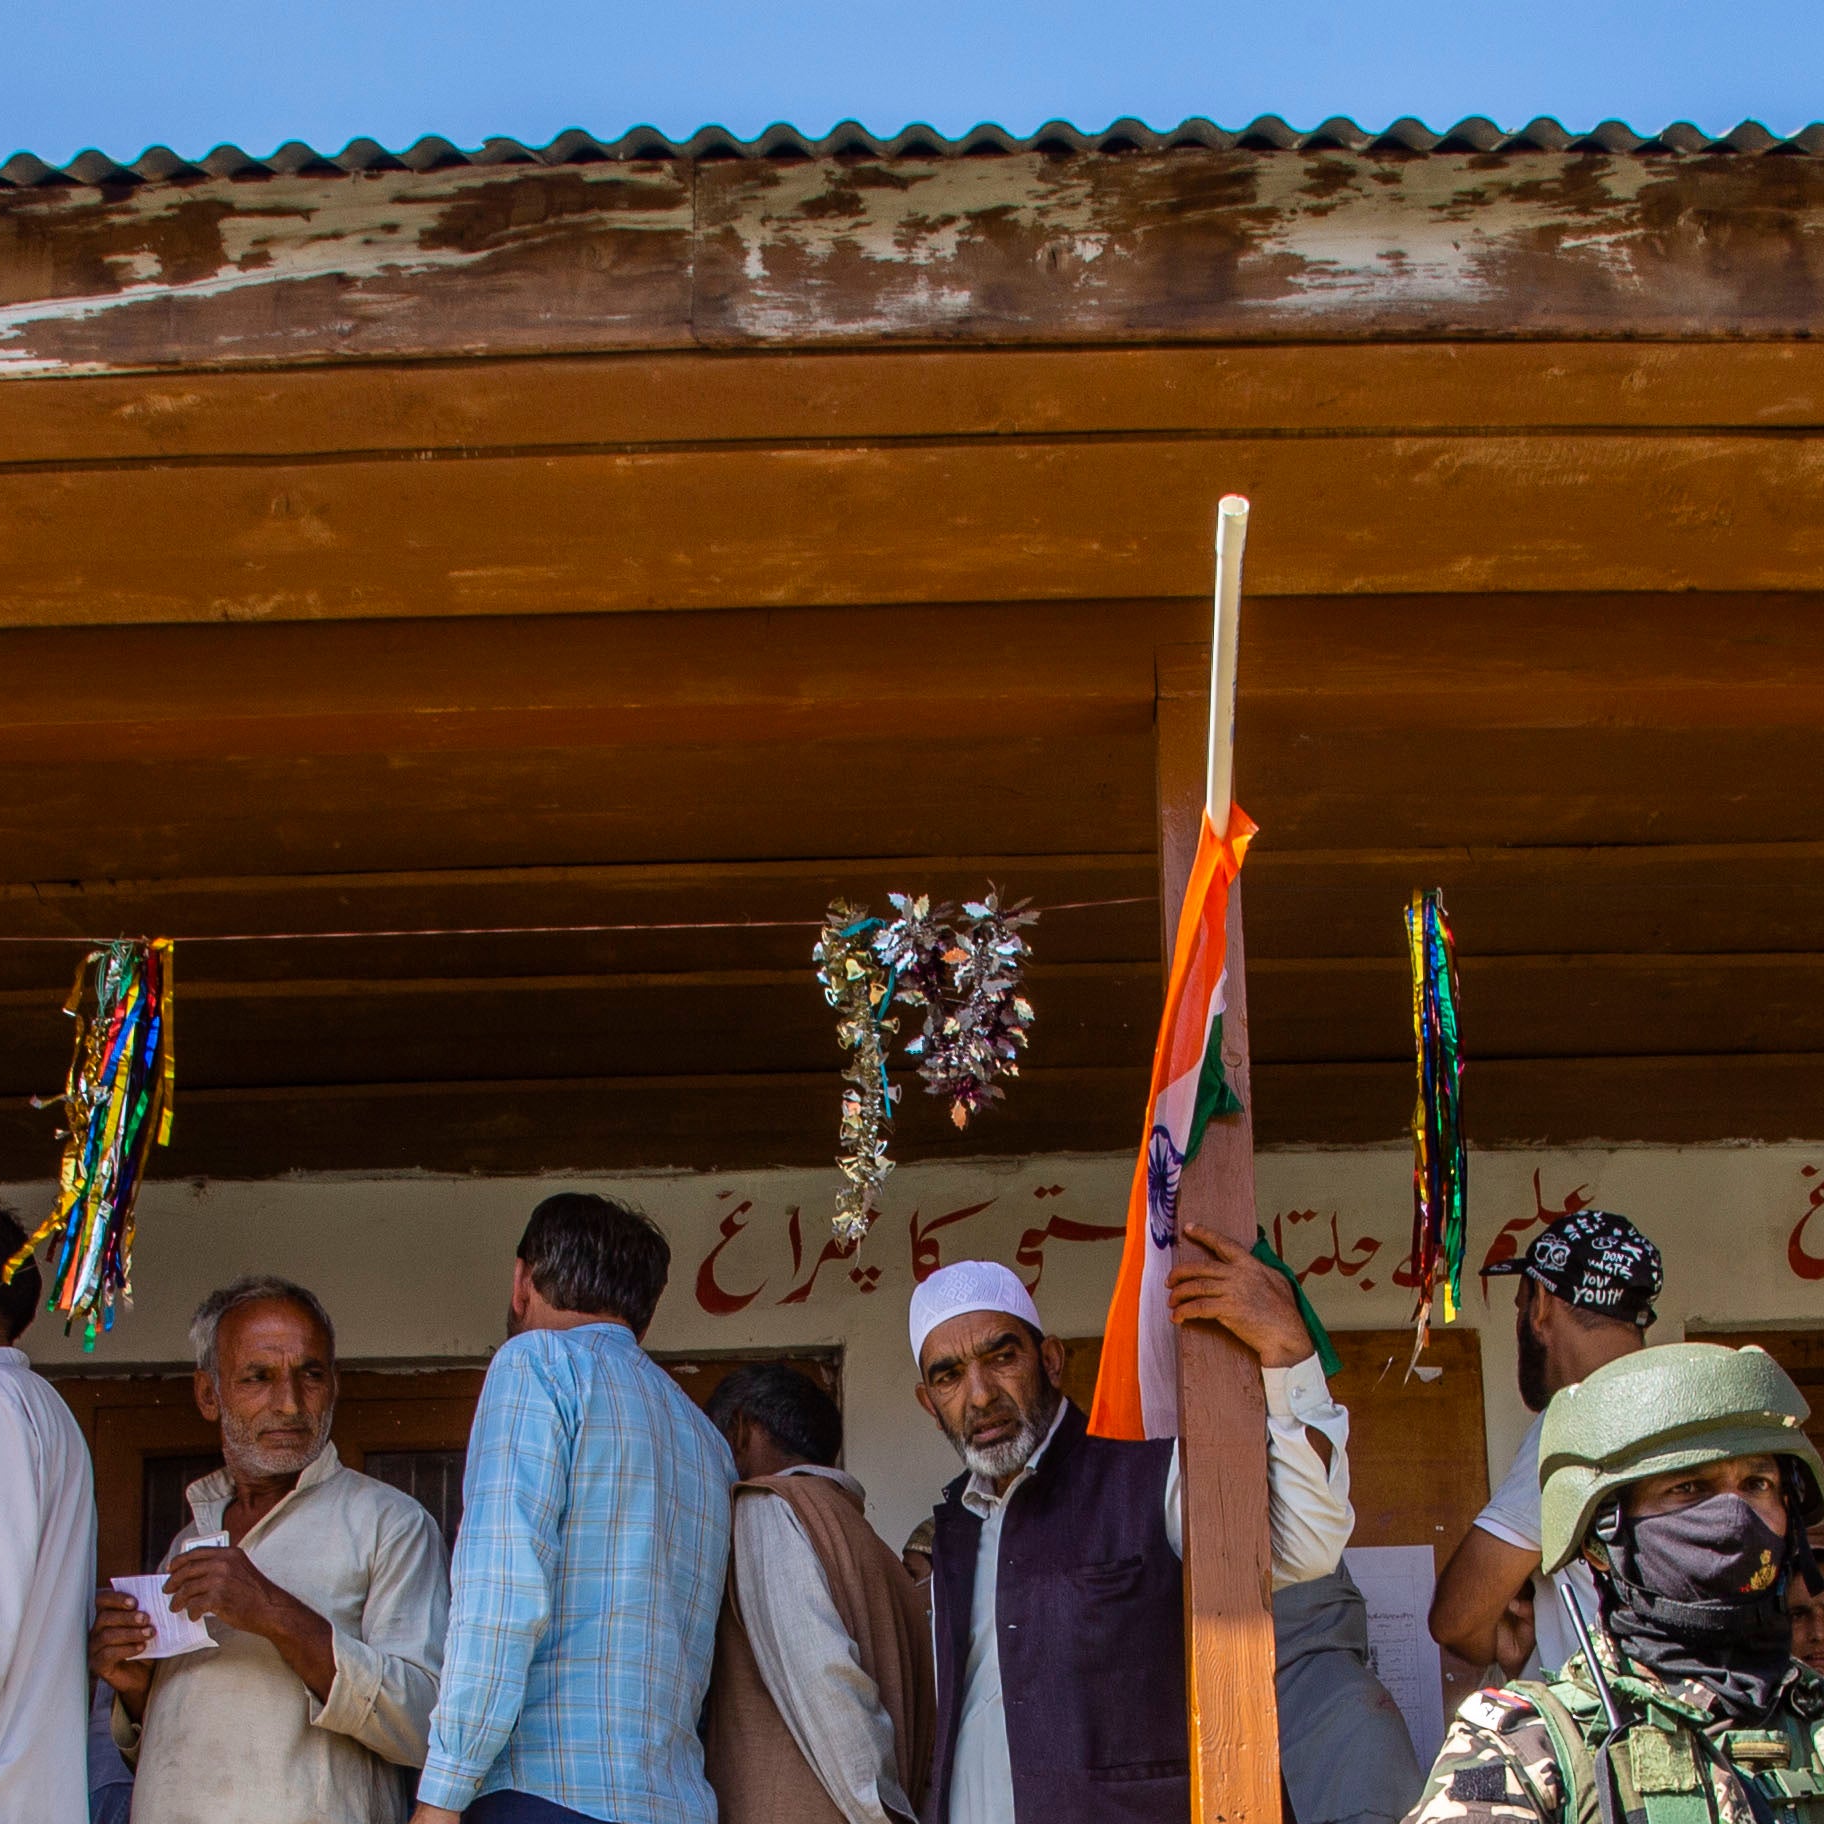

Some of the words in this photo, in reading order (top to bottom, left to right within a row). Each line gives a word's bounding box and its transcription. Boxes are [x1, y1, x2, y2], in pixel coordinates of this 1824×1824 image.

[1602, 1250, 1634, 1267] DON'T
[1586, 1257, 1633, 1280] WASTE
[1572, 1286, 1625, 1305] YOUTH
